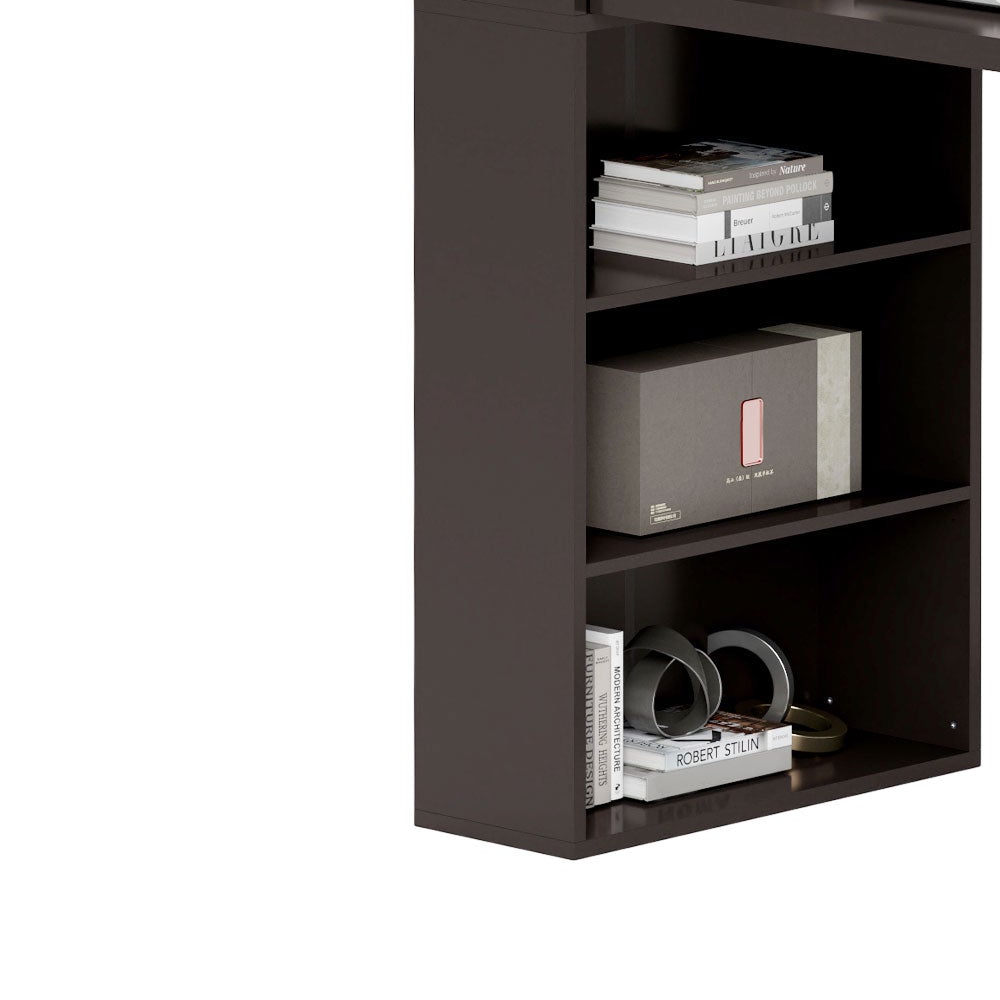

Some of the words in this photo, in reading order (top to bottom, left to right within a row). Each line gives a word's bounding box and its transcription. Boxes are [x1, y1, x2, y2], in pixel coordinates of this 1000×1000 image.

[778, 162, 807, 176] Nature
[722, 189, 755, 206] PAINTING
[756, 185, 785, 200] BEYOND
[786, 179, 817, 194] POLLOCK
[733, 217, 754, 227] Breuer
[585, 653, 594, 745] FURNITURE
[613, 666, 621, 704] MODERN
[598, 692, 608, 746] WUTHERING
[612, 706, 621, 772] ARCHITECTURE
[676, 745, 721, 767] ROBERT
[724, 737, 760, 757] STILIN
[585, 750, 595, 808] DESIGN
[598, 750, 608, 787] HEIGHTS
